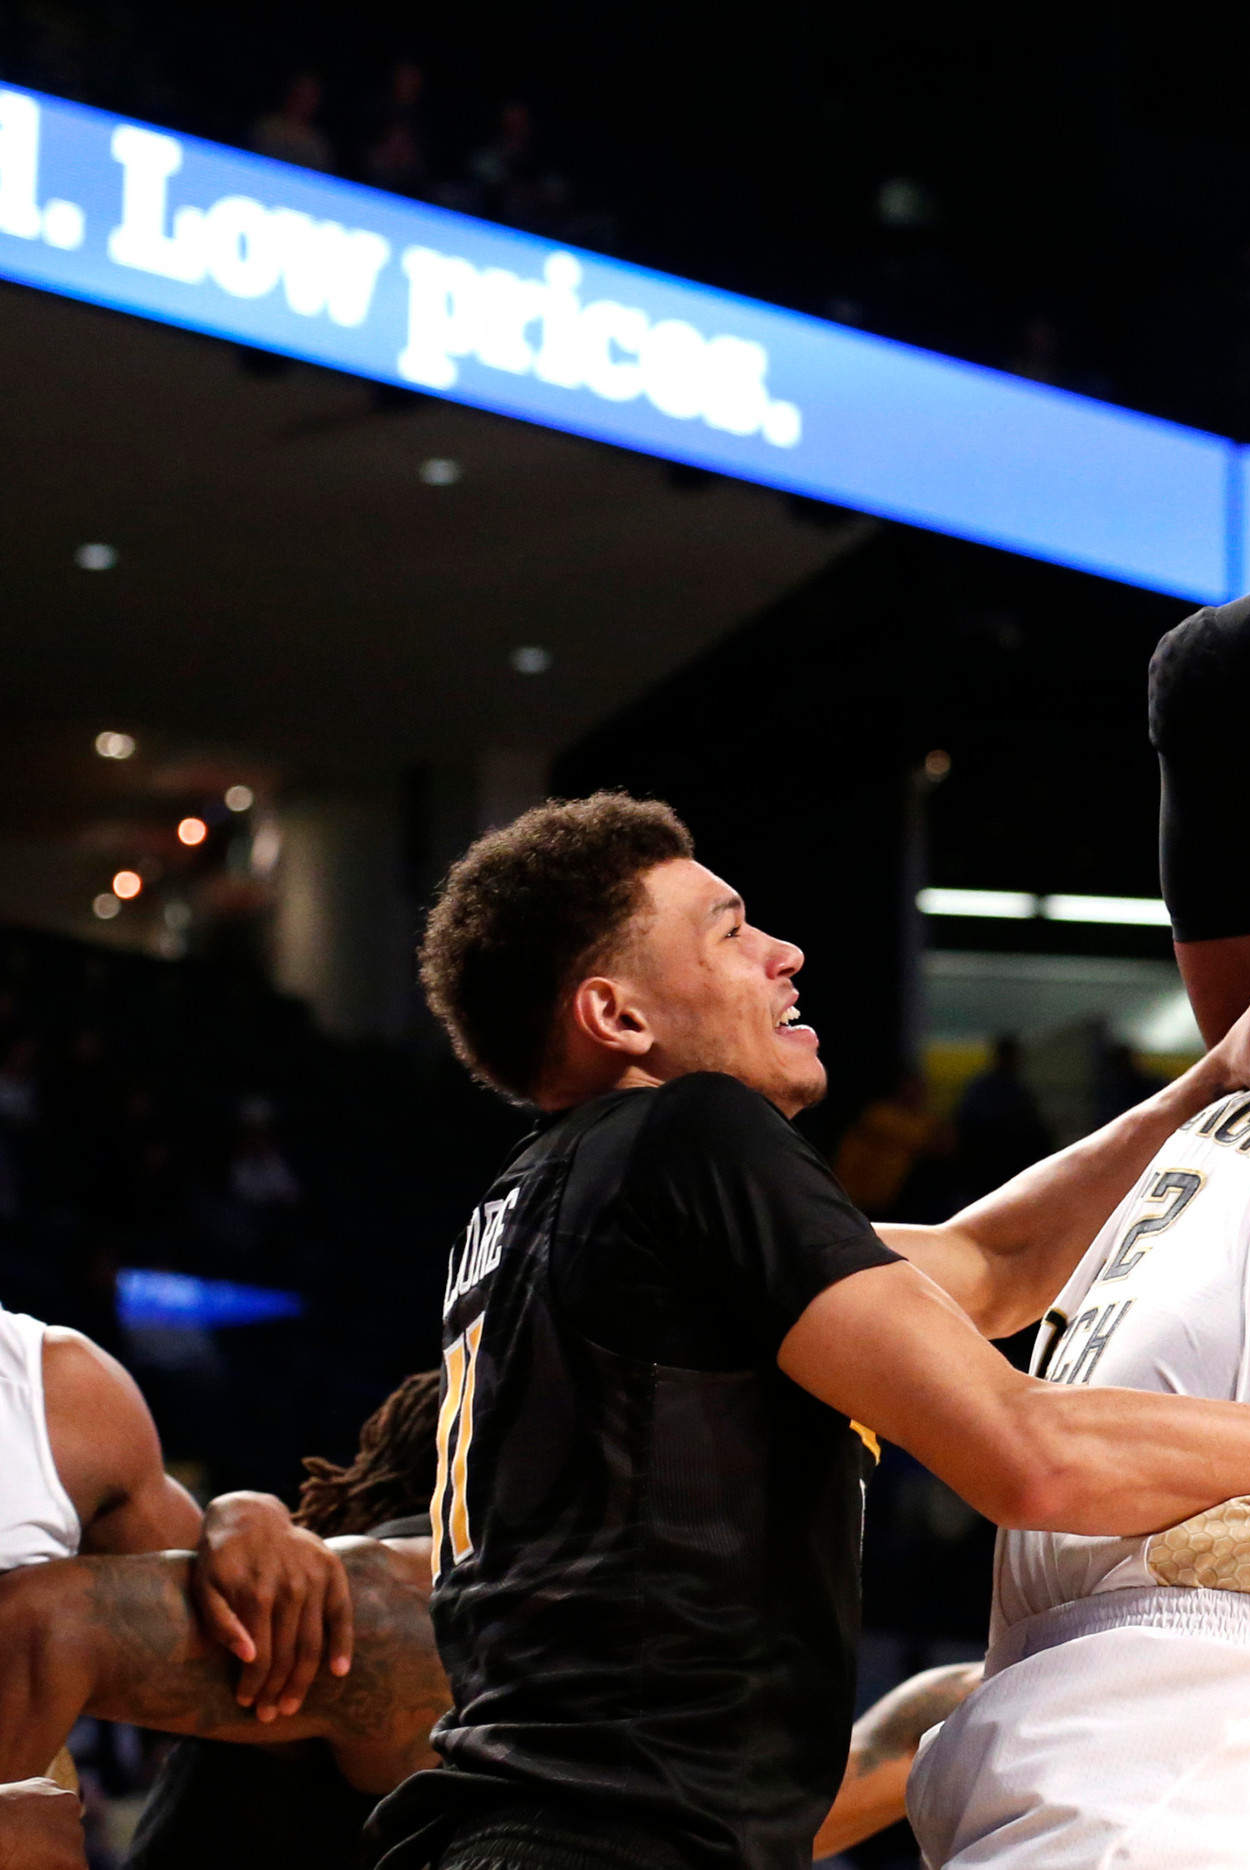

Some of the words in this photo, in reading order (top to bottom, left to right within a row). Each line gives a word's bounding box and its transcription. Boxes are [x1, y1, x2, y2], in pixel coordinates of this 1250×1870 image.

[108, 122, 391, 328] Low
[398, 246, 801, 449] prices.
[430, 1310, 486, 1588] 11
